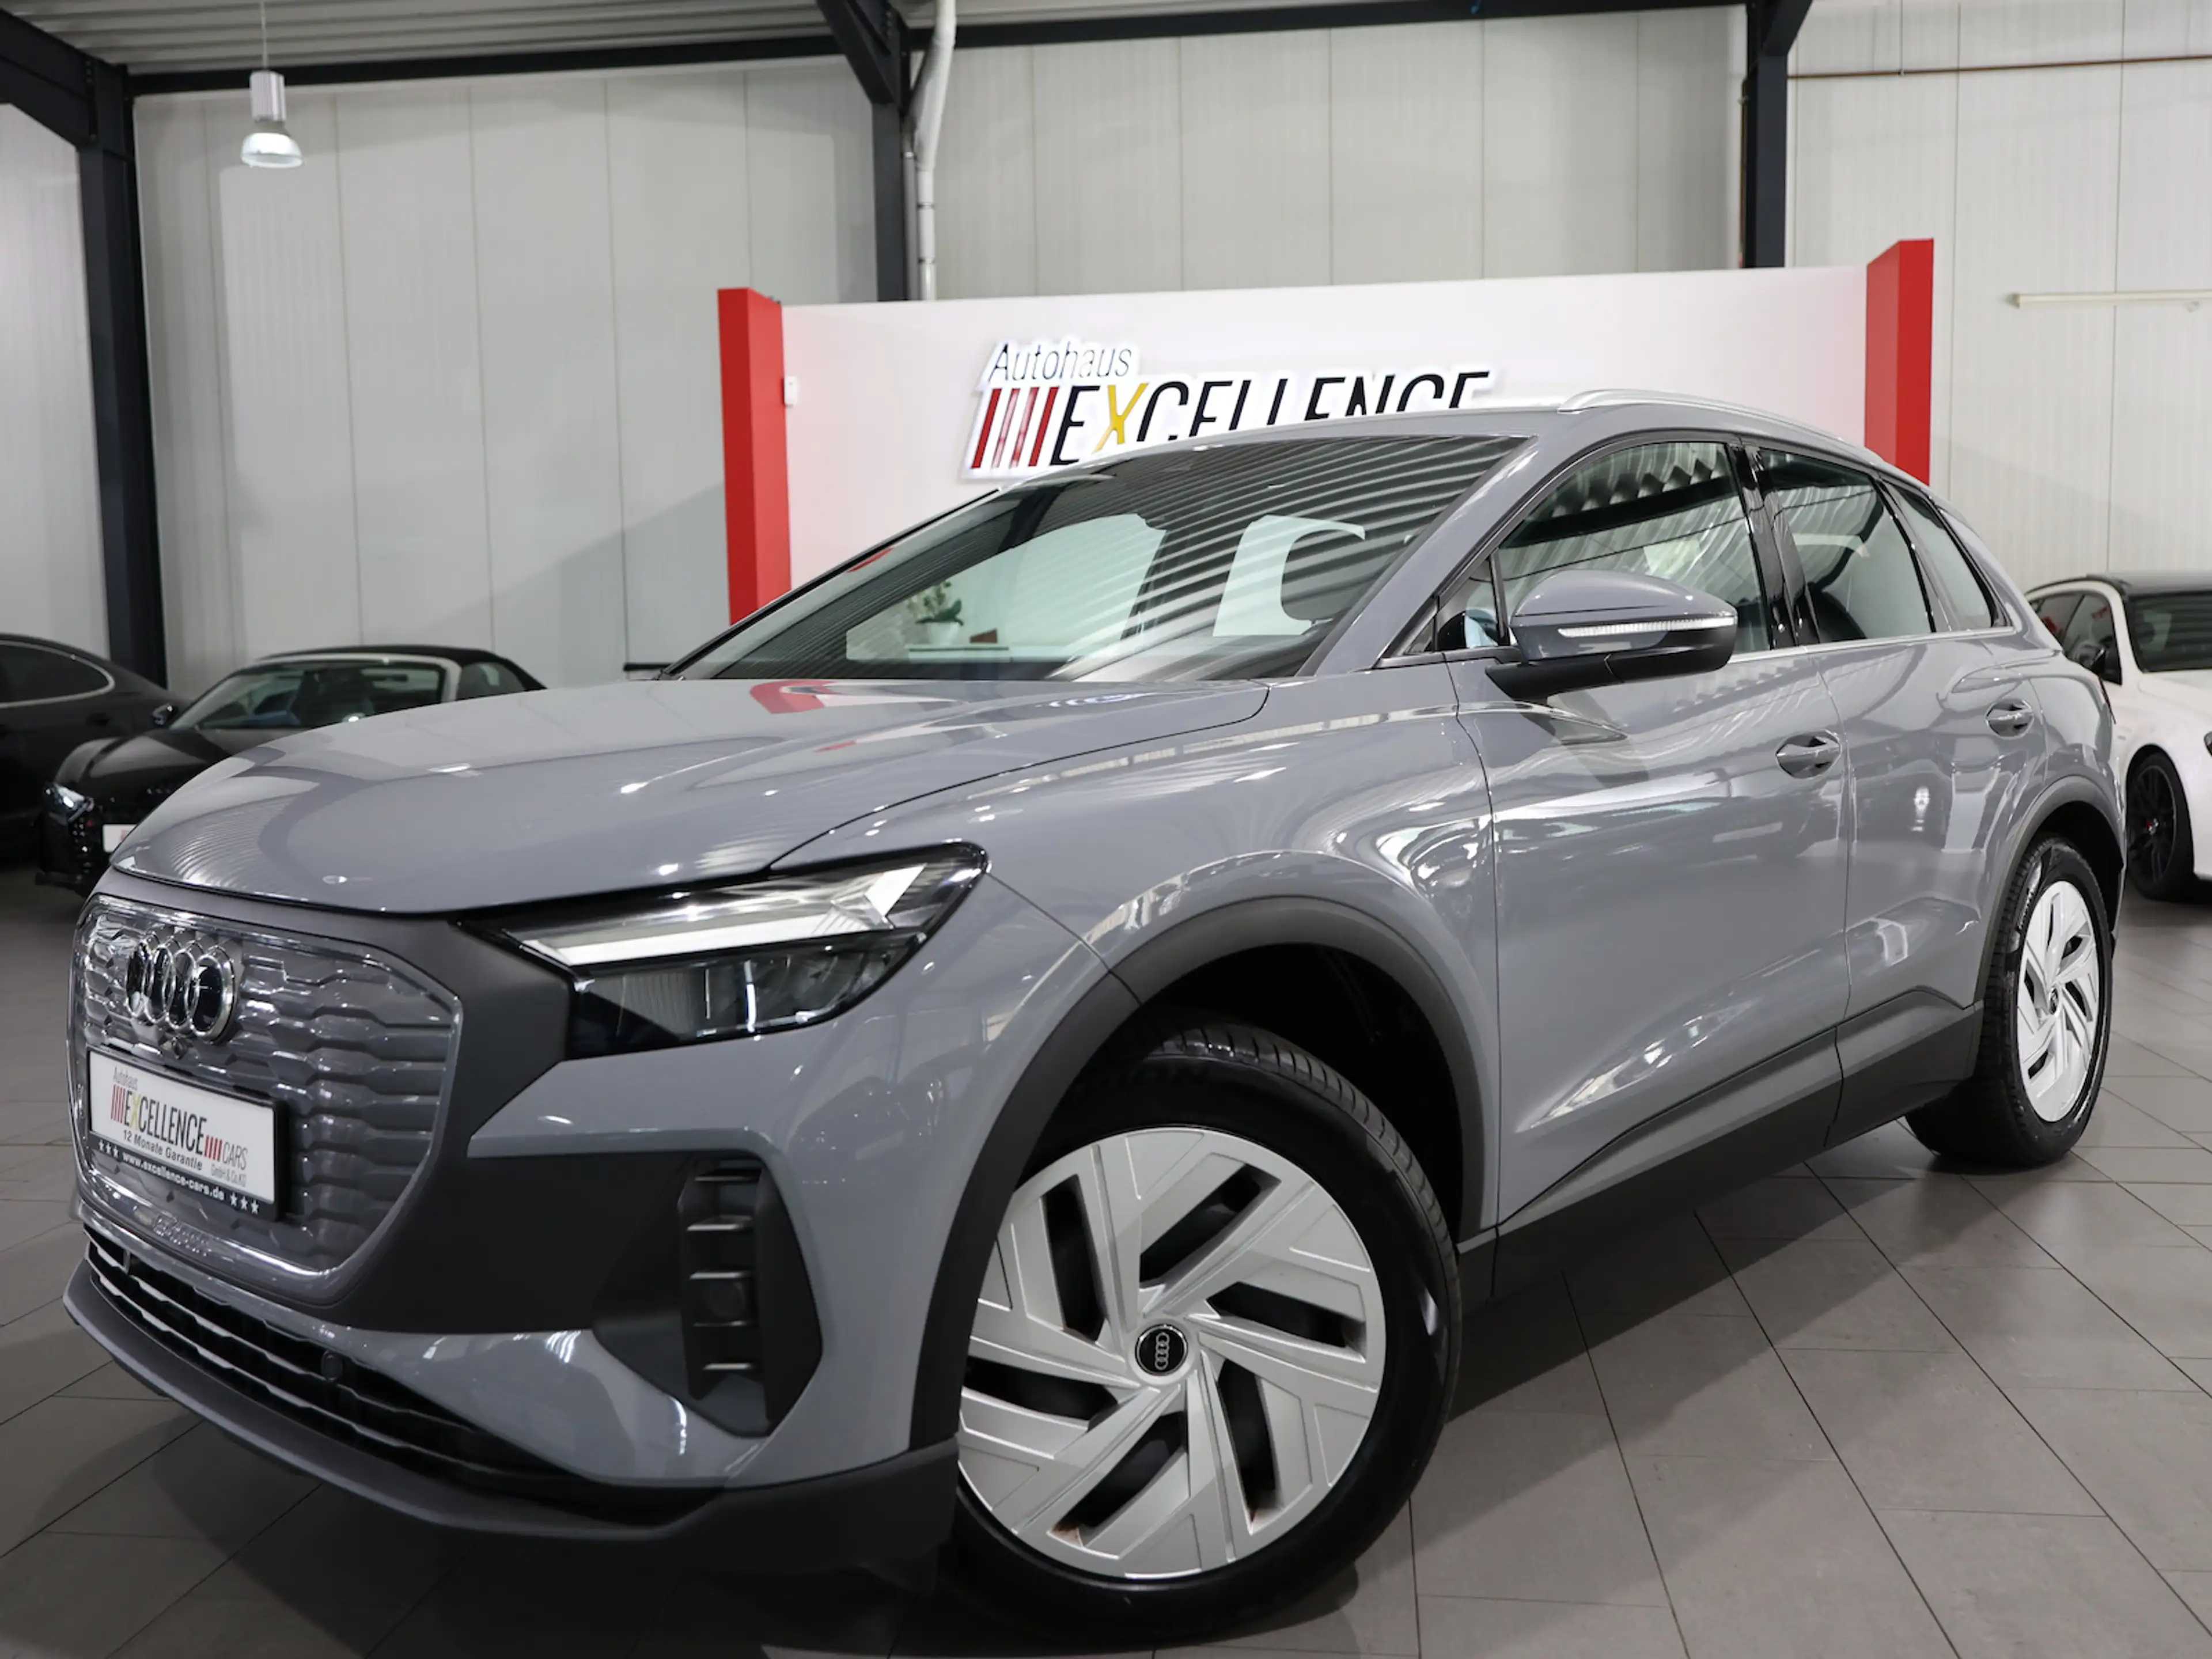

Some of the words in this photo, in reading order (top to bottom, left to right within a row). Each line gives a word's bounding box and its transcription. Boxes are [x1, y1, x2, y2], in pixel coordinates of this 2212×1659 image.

[987, 340, 1132, 382] Autohaus
[123, 1130, 132, 1143] 12
[134, 1133, 164, 1155] Monate
[165, 1147, 203, 1171] Garantie
[124, 1090, 207, 1156] EXCELLENCE
[222, 1142, 248, 1171] CARS
[122, 1152, 225, 1201] www.excellence-cars.de
